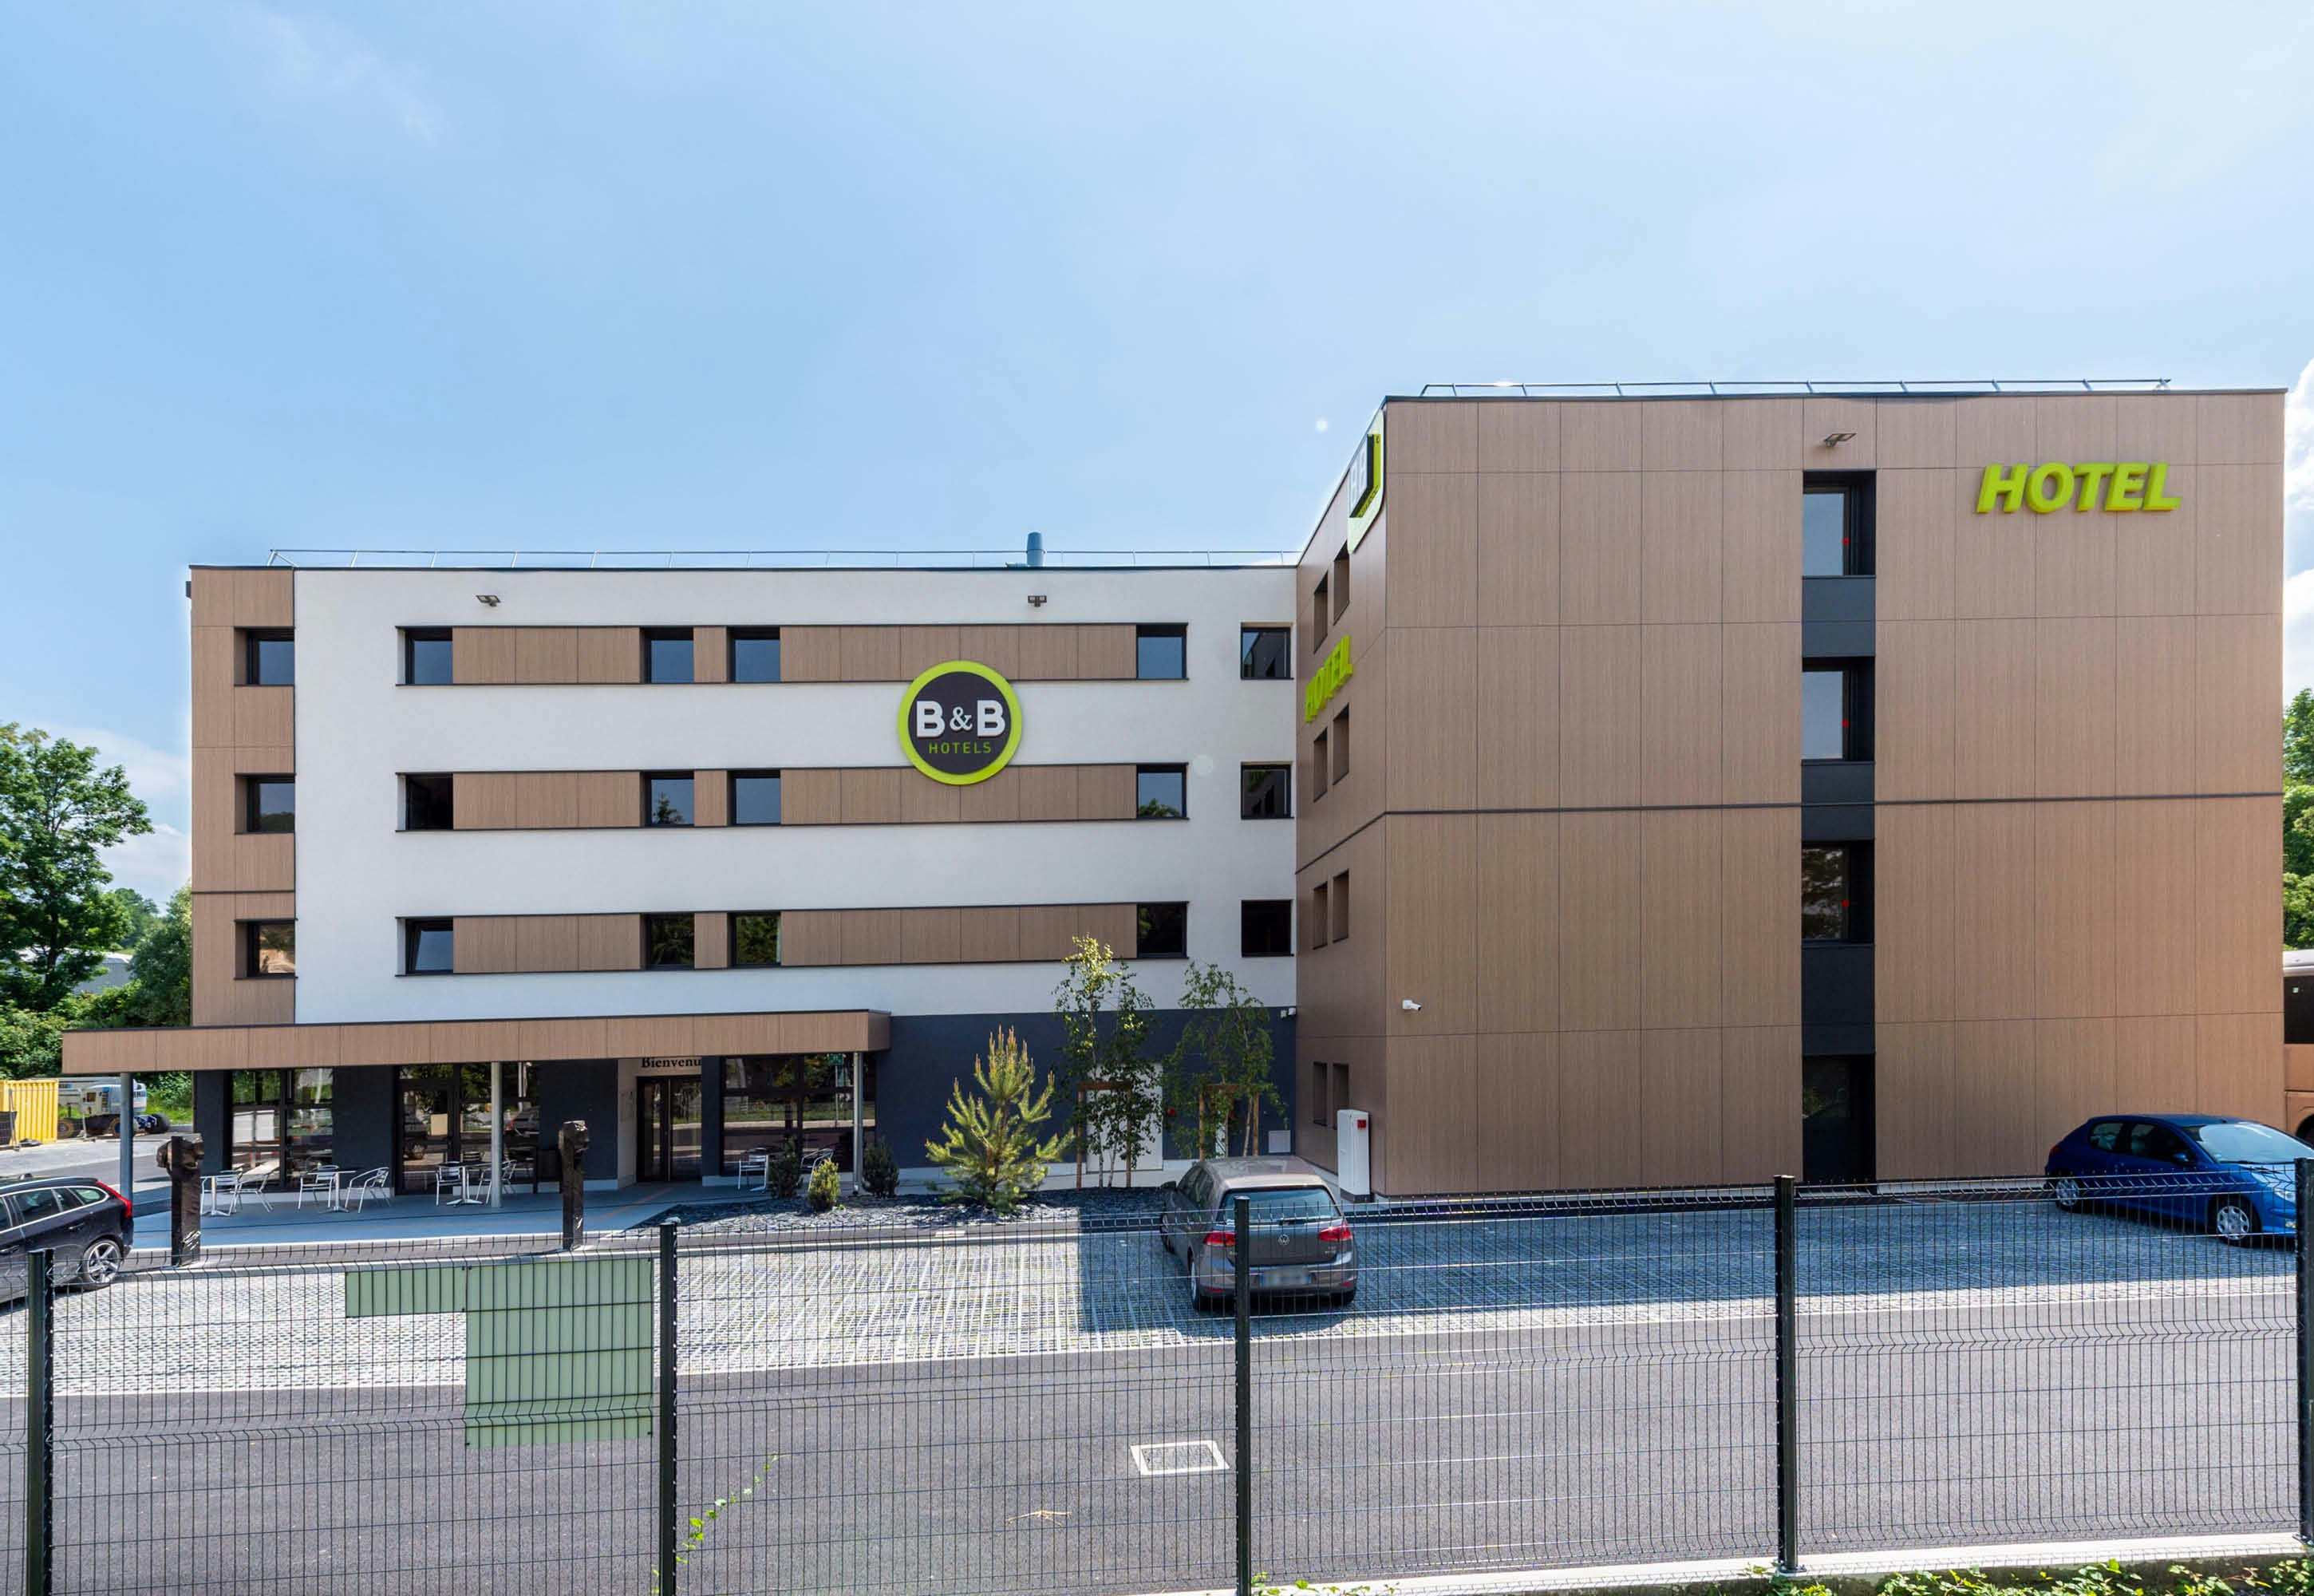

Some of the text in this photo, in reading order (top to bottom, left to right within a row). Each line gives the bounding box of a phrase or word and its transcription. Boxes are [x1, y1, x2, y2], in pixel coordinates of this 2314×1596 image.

[1976, 462, 2182, 513] HOTEL
[1305, 635, 1353, 722] HOTEL
[917, 700, 1005, 738] B&B
[928, 742, 992, 754] HOTELS
[642, 1057, 701, 1068] Bienvenu
